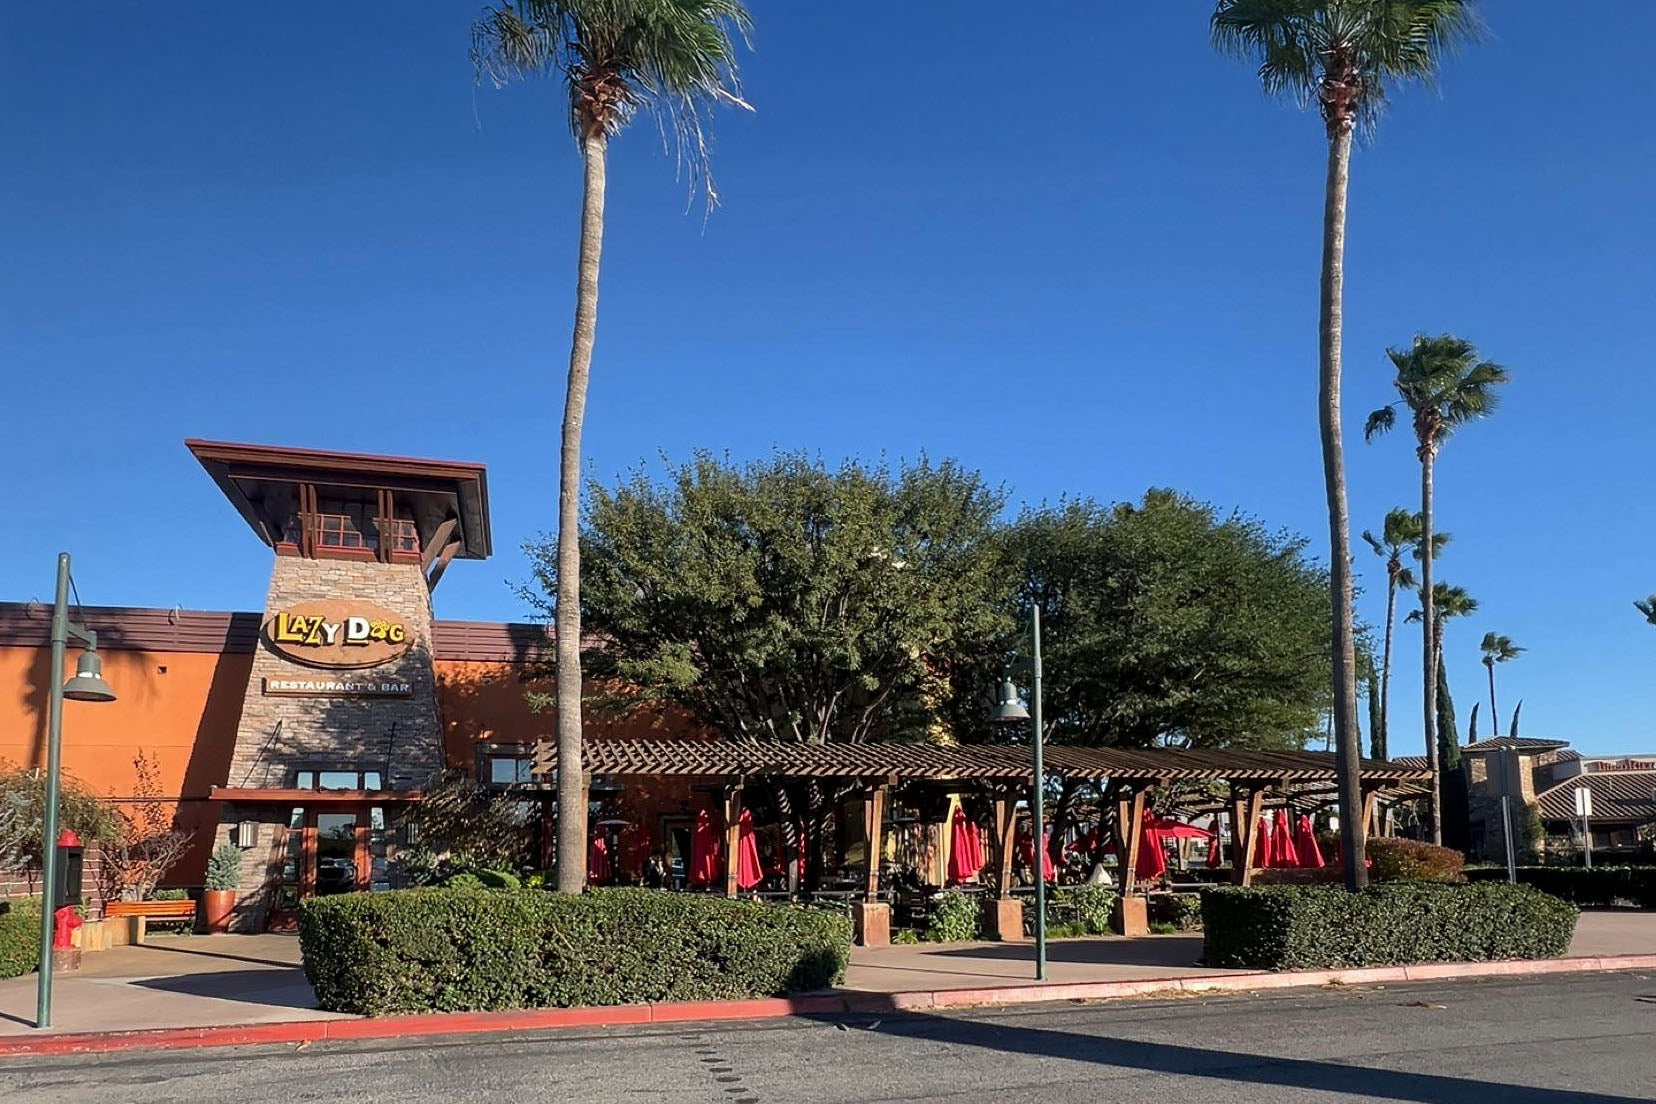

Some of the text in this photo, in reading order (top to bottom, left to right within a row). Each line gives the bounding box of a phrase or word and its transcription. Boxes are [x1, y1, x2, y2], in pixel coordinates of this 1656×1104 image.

[276, 612, 404, 646] LAZY DOG
[270, 680, 409, 692] RESTAURANT & BAR
